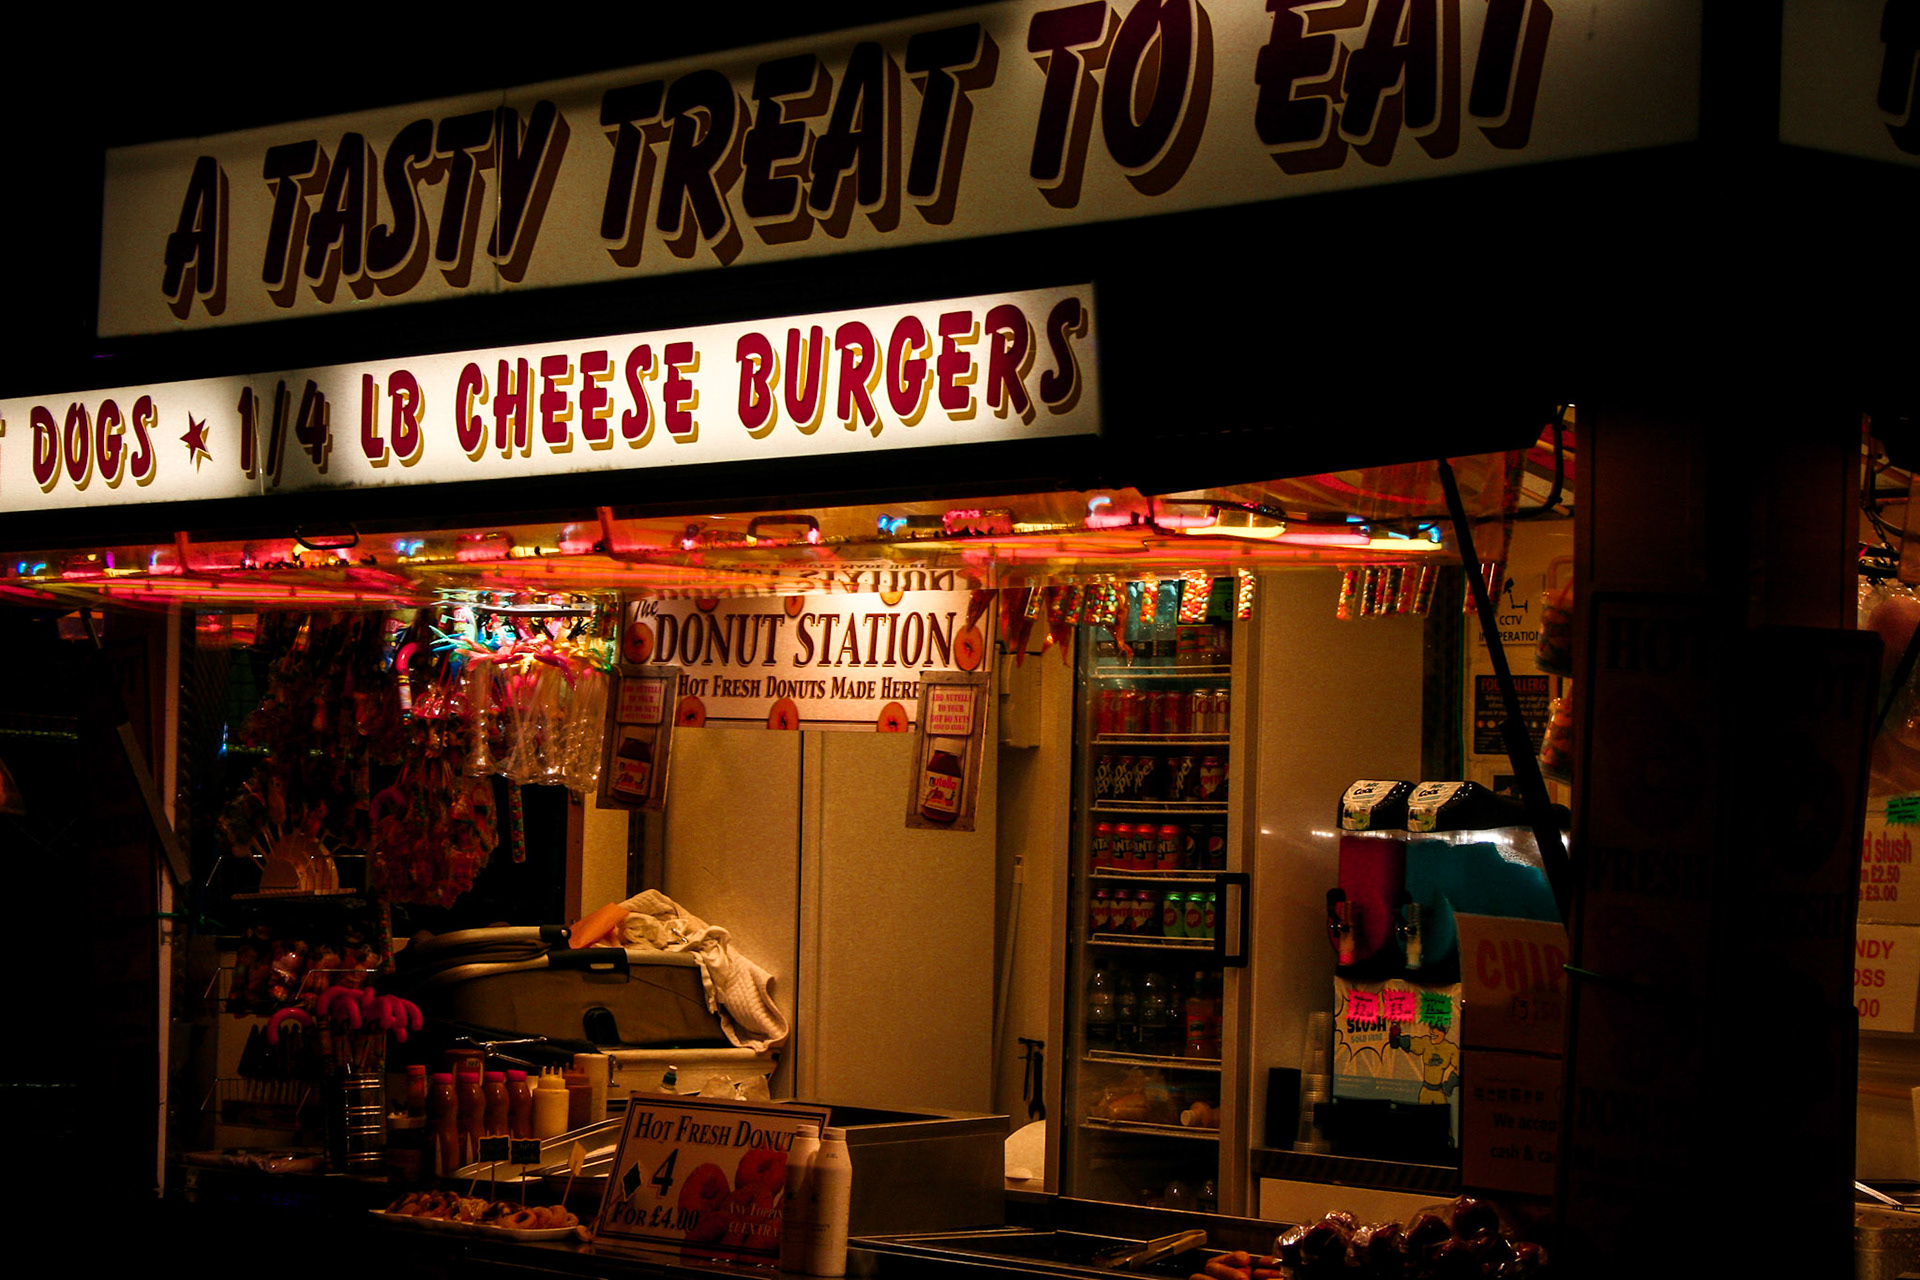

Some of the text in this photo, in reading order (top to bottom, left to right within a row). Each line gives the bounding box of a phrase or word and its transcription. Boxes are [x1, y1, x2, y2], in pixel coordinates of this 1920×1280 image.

[163, 156, 229, 320] A
[262, 100, 570, 308] TASTY
[600, 22, 998, 267] TREAT
[1028, 0, 1214, 209] TO
[30, 297, 1088, 493] DOGS 1/4 LB CHEESE BURGERS
[633, 600, 660, 622] The
[1499, 615, 1523, 626] CCTV
[652, 611, 958, 668] DONUT STATION
[712, 674, 762, 700] FRESH
[765, 675, 828, 701] DONUTS
[830, 676, 879, 701] MADE
[1875, 830, 1912, 863] slush
[1865, 884, 1898, 901] £3.00
[634, 1112, 673, 1140] HOT
[678, 1115, 734, 1147] FRESH
[651, 1148, 680, 1199] 4
[612, 1202, 700, 1232] FOR £4.00
